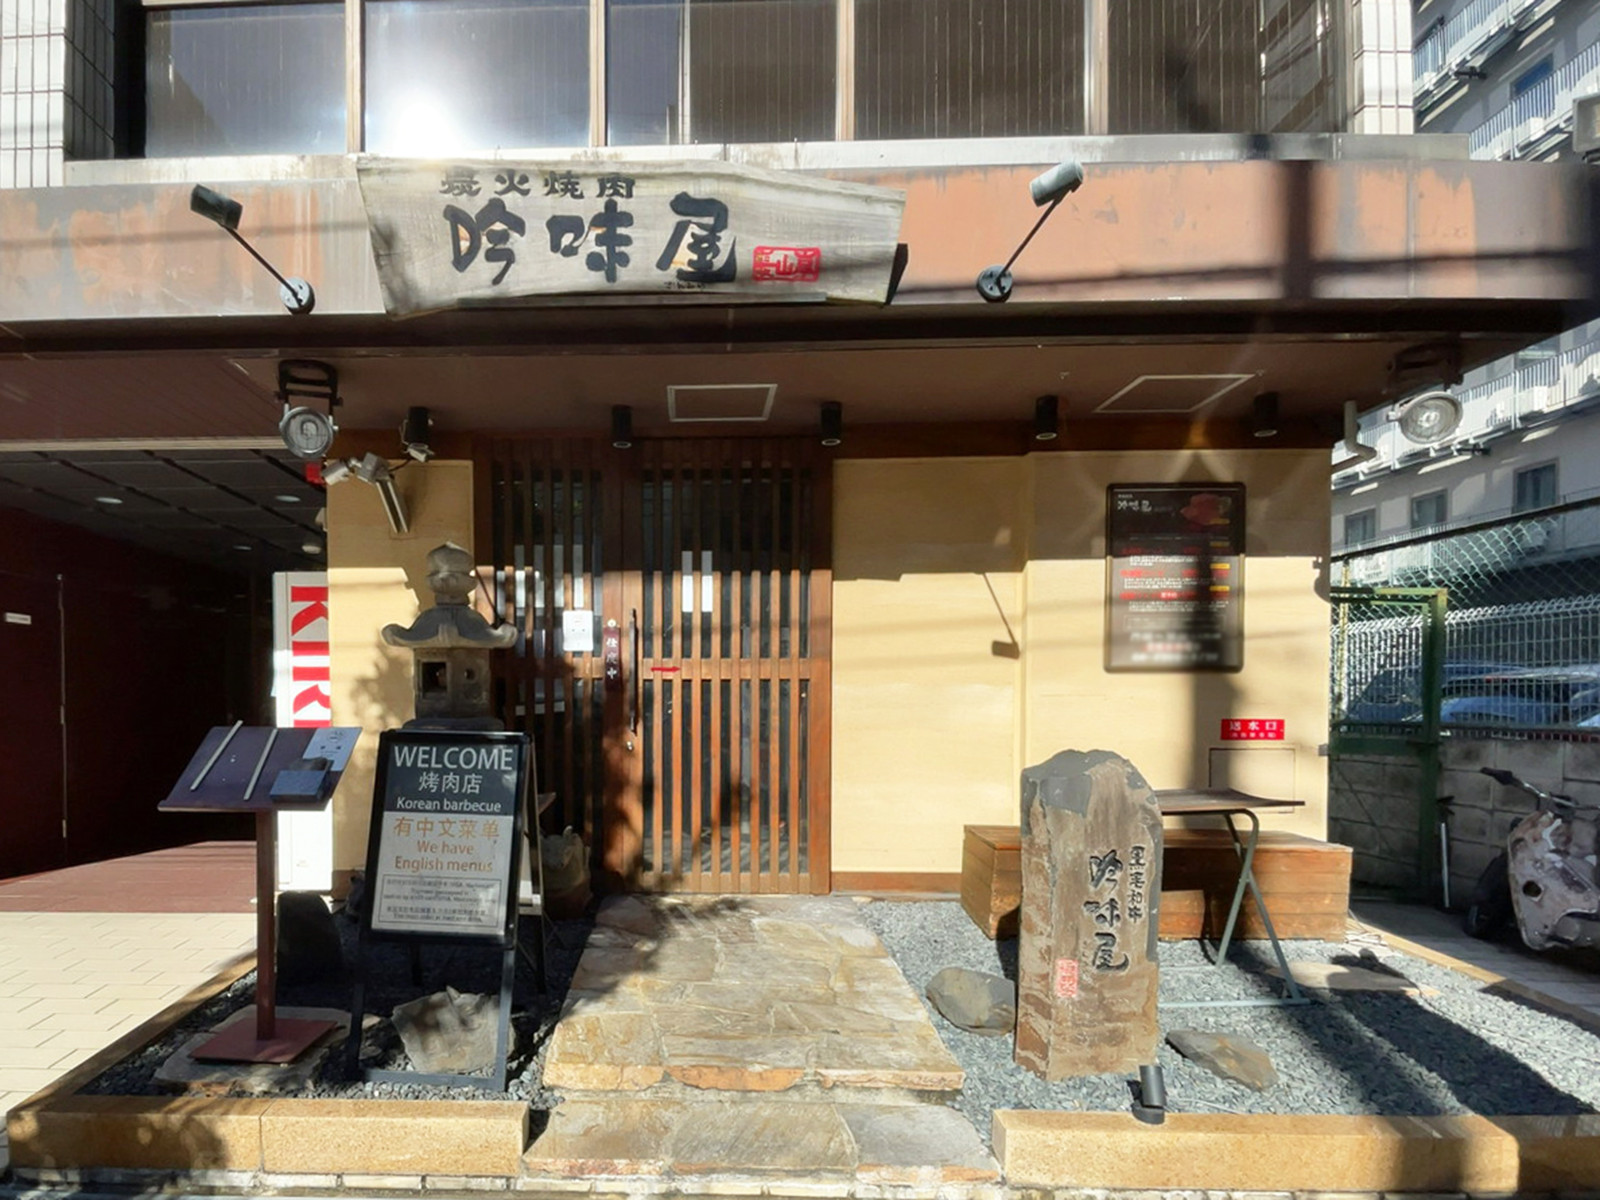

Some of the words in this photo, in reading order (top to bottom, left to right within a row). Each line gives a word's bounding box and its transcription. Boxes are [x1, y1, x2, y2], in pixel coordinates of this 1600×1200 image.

[440, 169, 635, 199] 炭火焼肉
[443, 193, 737, 285] 吟味屋
[394, 746, 513, 770] WELCOME
[418, 772, 483, 794] 烤肉店
[396, 797, 440, 811] Korean
[443, 798, 501, 812] barbecue
[393, 817, 500, 839] 有中文菜单
[417, 841, 438, 853] We
[441, 841, 474, 855] have
[395, 856, 443, 873] English
[446, 859, 493, 873] menus
[1127, 845, 1147, 924] 黒毛和牛
[1083, 849, 1129, 972] 吟味屋
